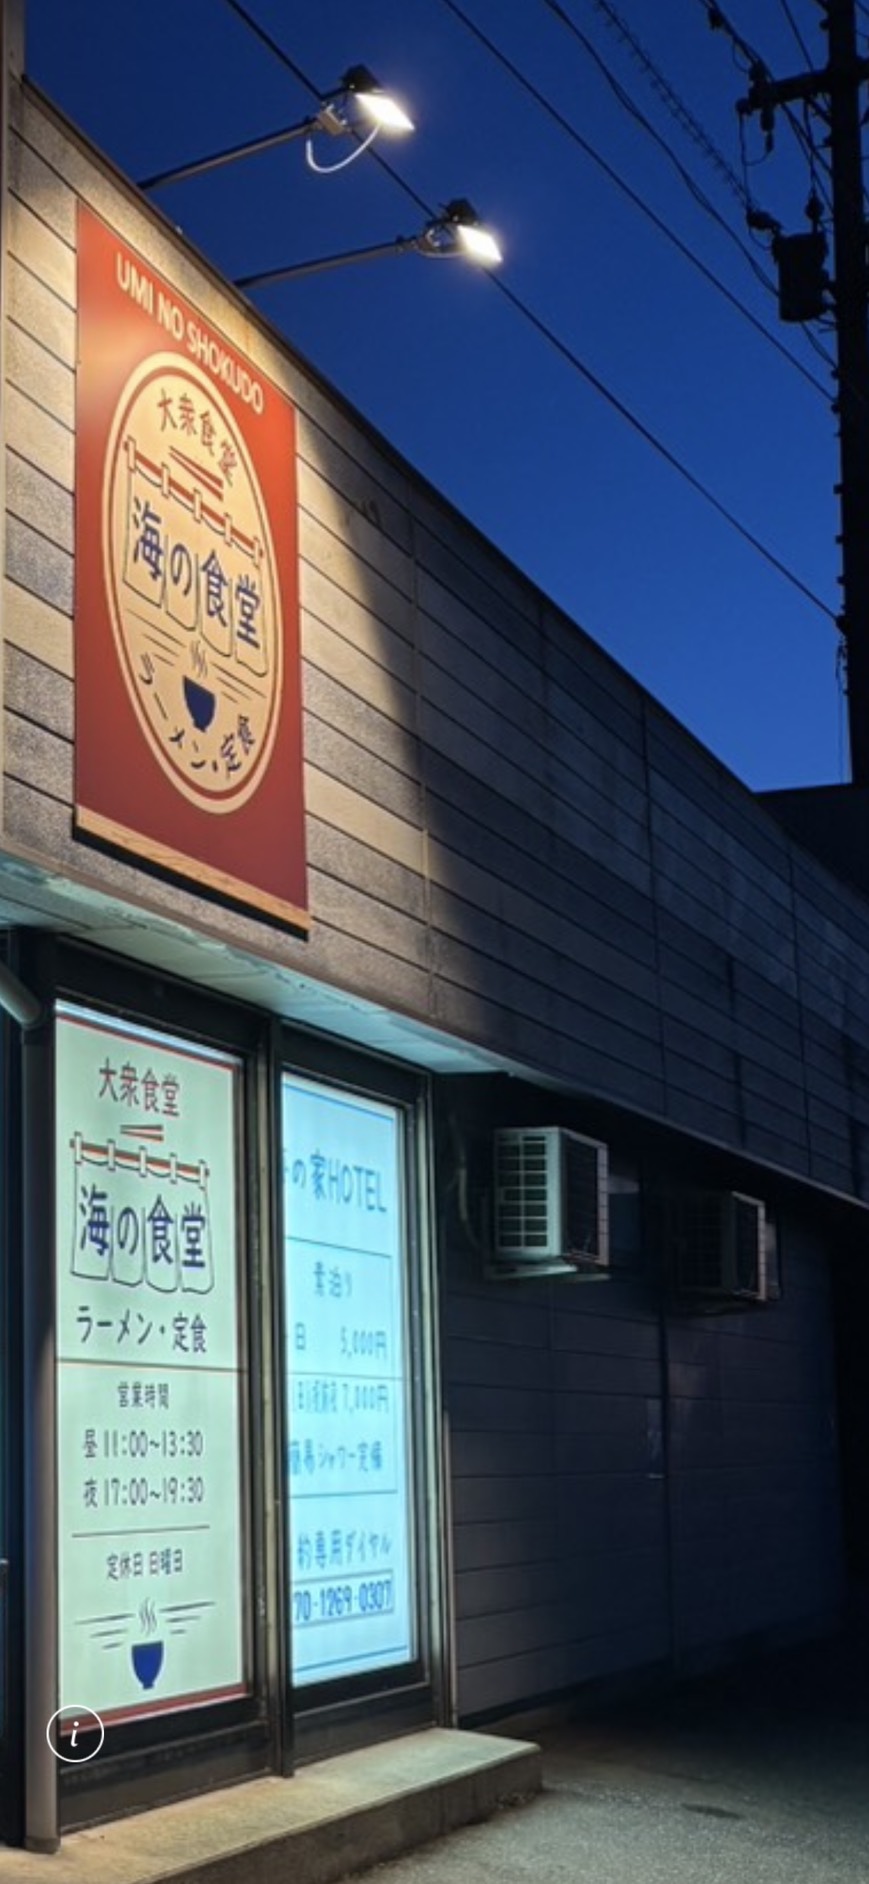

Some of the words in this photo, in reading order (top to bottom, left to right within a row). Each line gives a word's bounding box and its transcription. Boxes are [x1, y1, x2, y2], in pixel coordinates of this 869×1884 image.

[116, 251, 155, 317] UMI
[158, 291, 184, 343] NO
[186, 320, 264, 415] SHOKUDO
[157, 387, 238, 488] 大衆食堂
[132, 496, 261, 649] 海の食堂
[98, 1056, 181, 1117] 大衆食堂
[284, 1146, 387, 1213] の家HOTEL
[79, 1183, 206, 1270] 海の食堂
[76, 1305, 207, 1354] ラーメン・定食
[117, 1381, 169, 1409] 営業時間
[83, 1428, 98, 1459] 昼
[83, 1477, 98, 1508] 夜
[106, 1551, 143, 1581] 定休日
[149, 1547, 183, 1576] 日曜日
